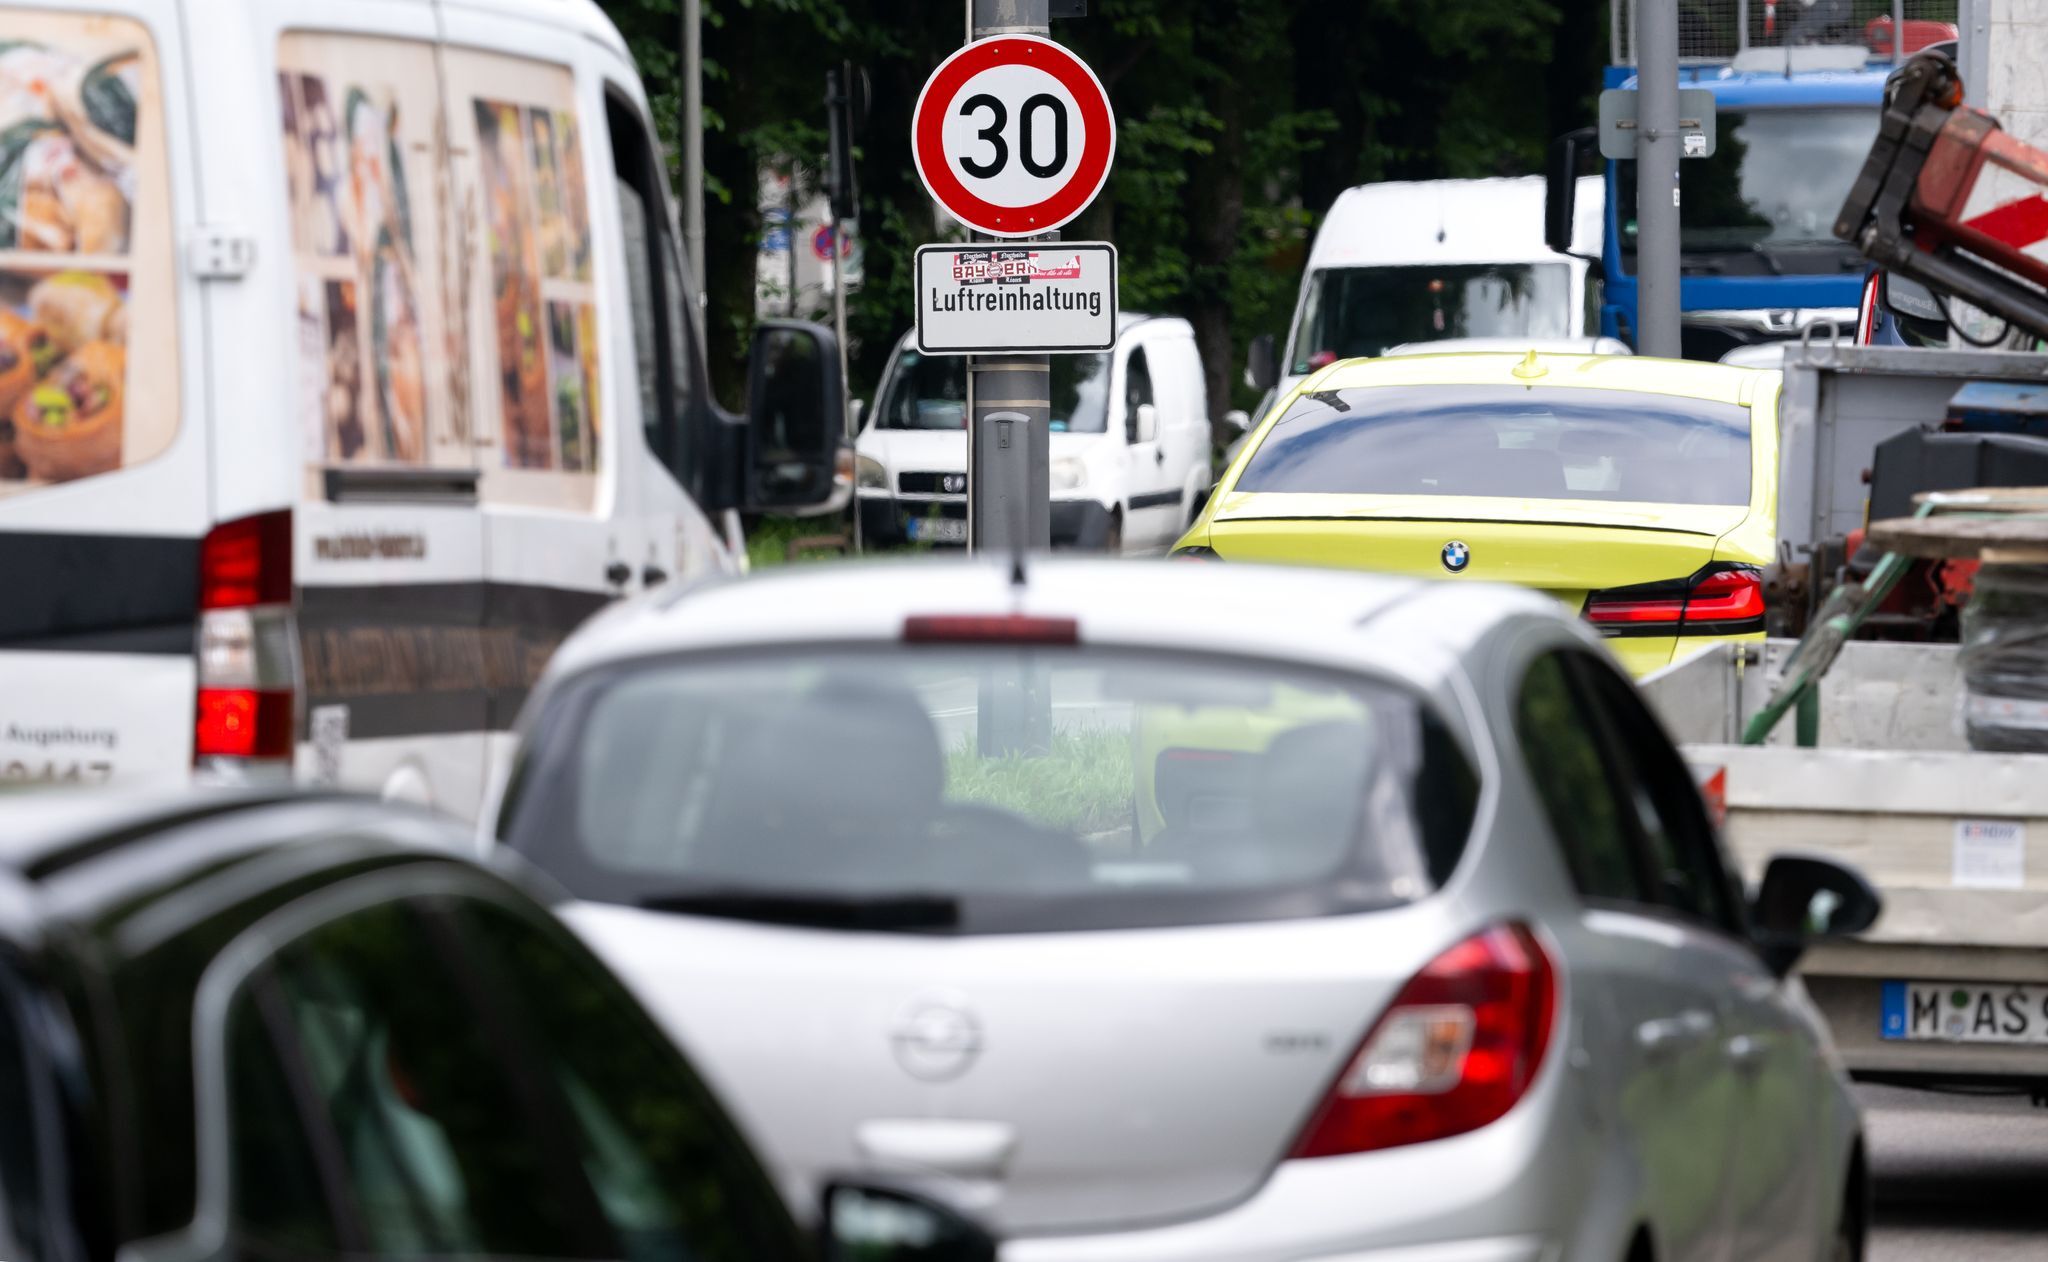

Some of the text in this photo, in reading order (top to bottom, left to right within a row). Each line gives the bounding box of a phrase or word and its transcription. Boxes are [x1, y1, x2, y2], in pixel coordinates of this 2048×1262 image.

[959, 93, 1069, 179] 30
[932, 286, 1101, 316] Luftreinhaltung
[1912, 990, 1938, 1032] M
[1973, 991, 2028, 1035] AS
